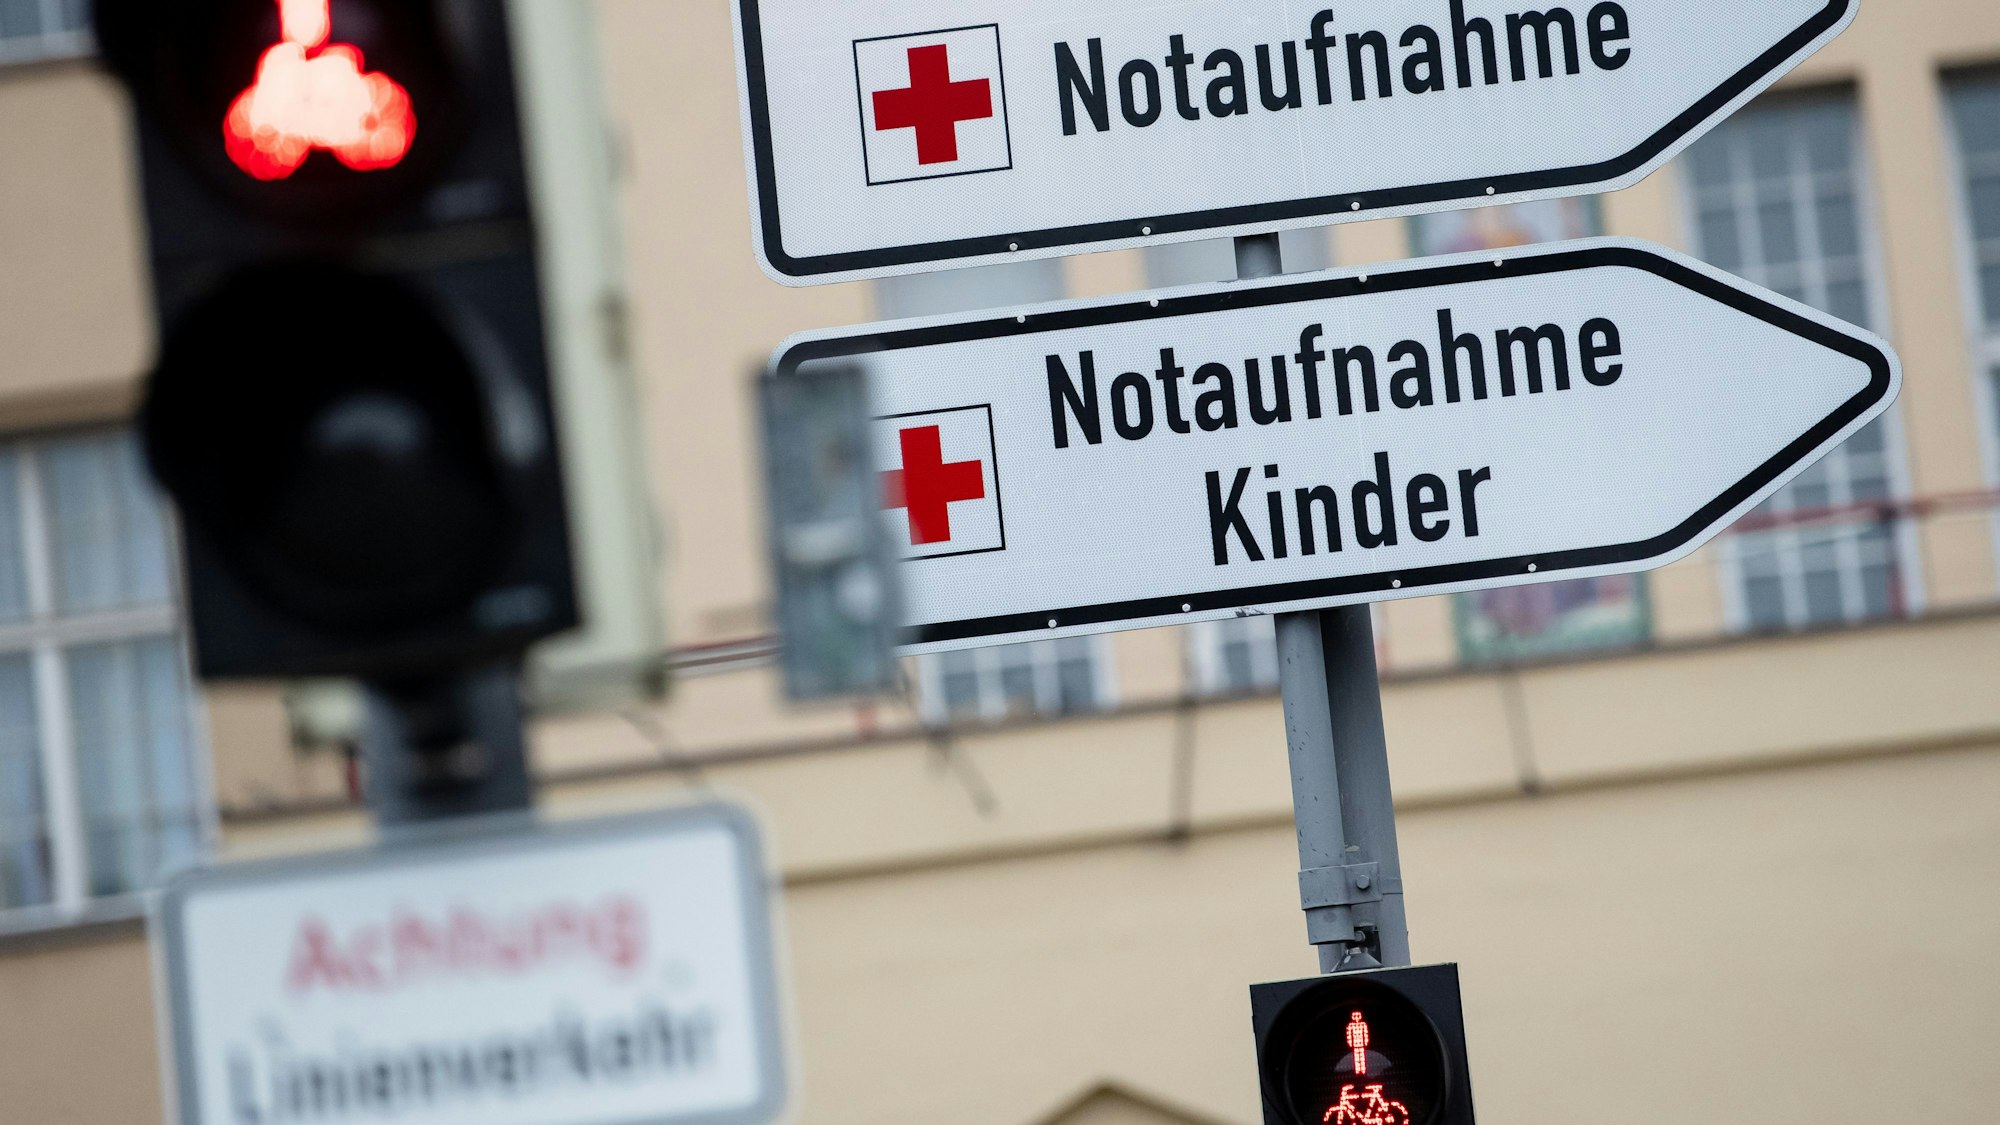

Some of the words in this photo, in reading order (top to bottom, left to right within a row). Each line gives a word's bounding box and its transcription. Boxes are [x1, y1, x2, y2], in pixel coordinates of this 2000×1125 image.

[1054, 0, 1631, 136] Notaufnahme
[1046, 308, 1623, 449] Notaufnahme
[1205, 451, 1491, 567] Kinder
[288, 896, 645, 992] Achtung
[226, 1003, 716, 1125] Linienverkehr
